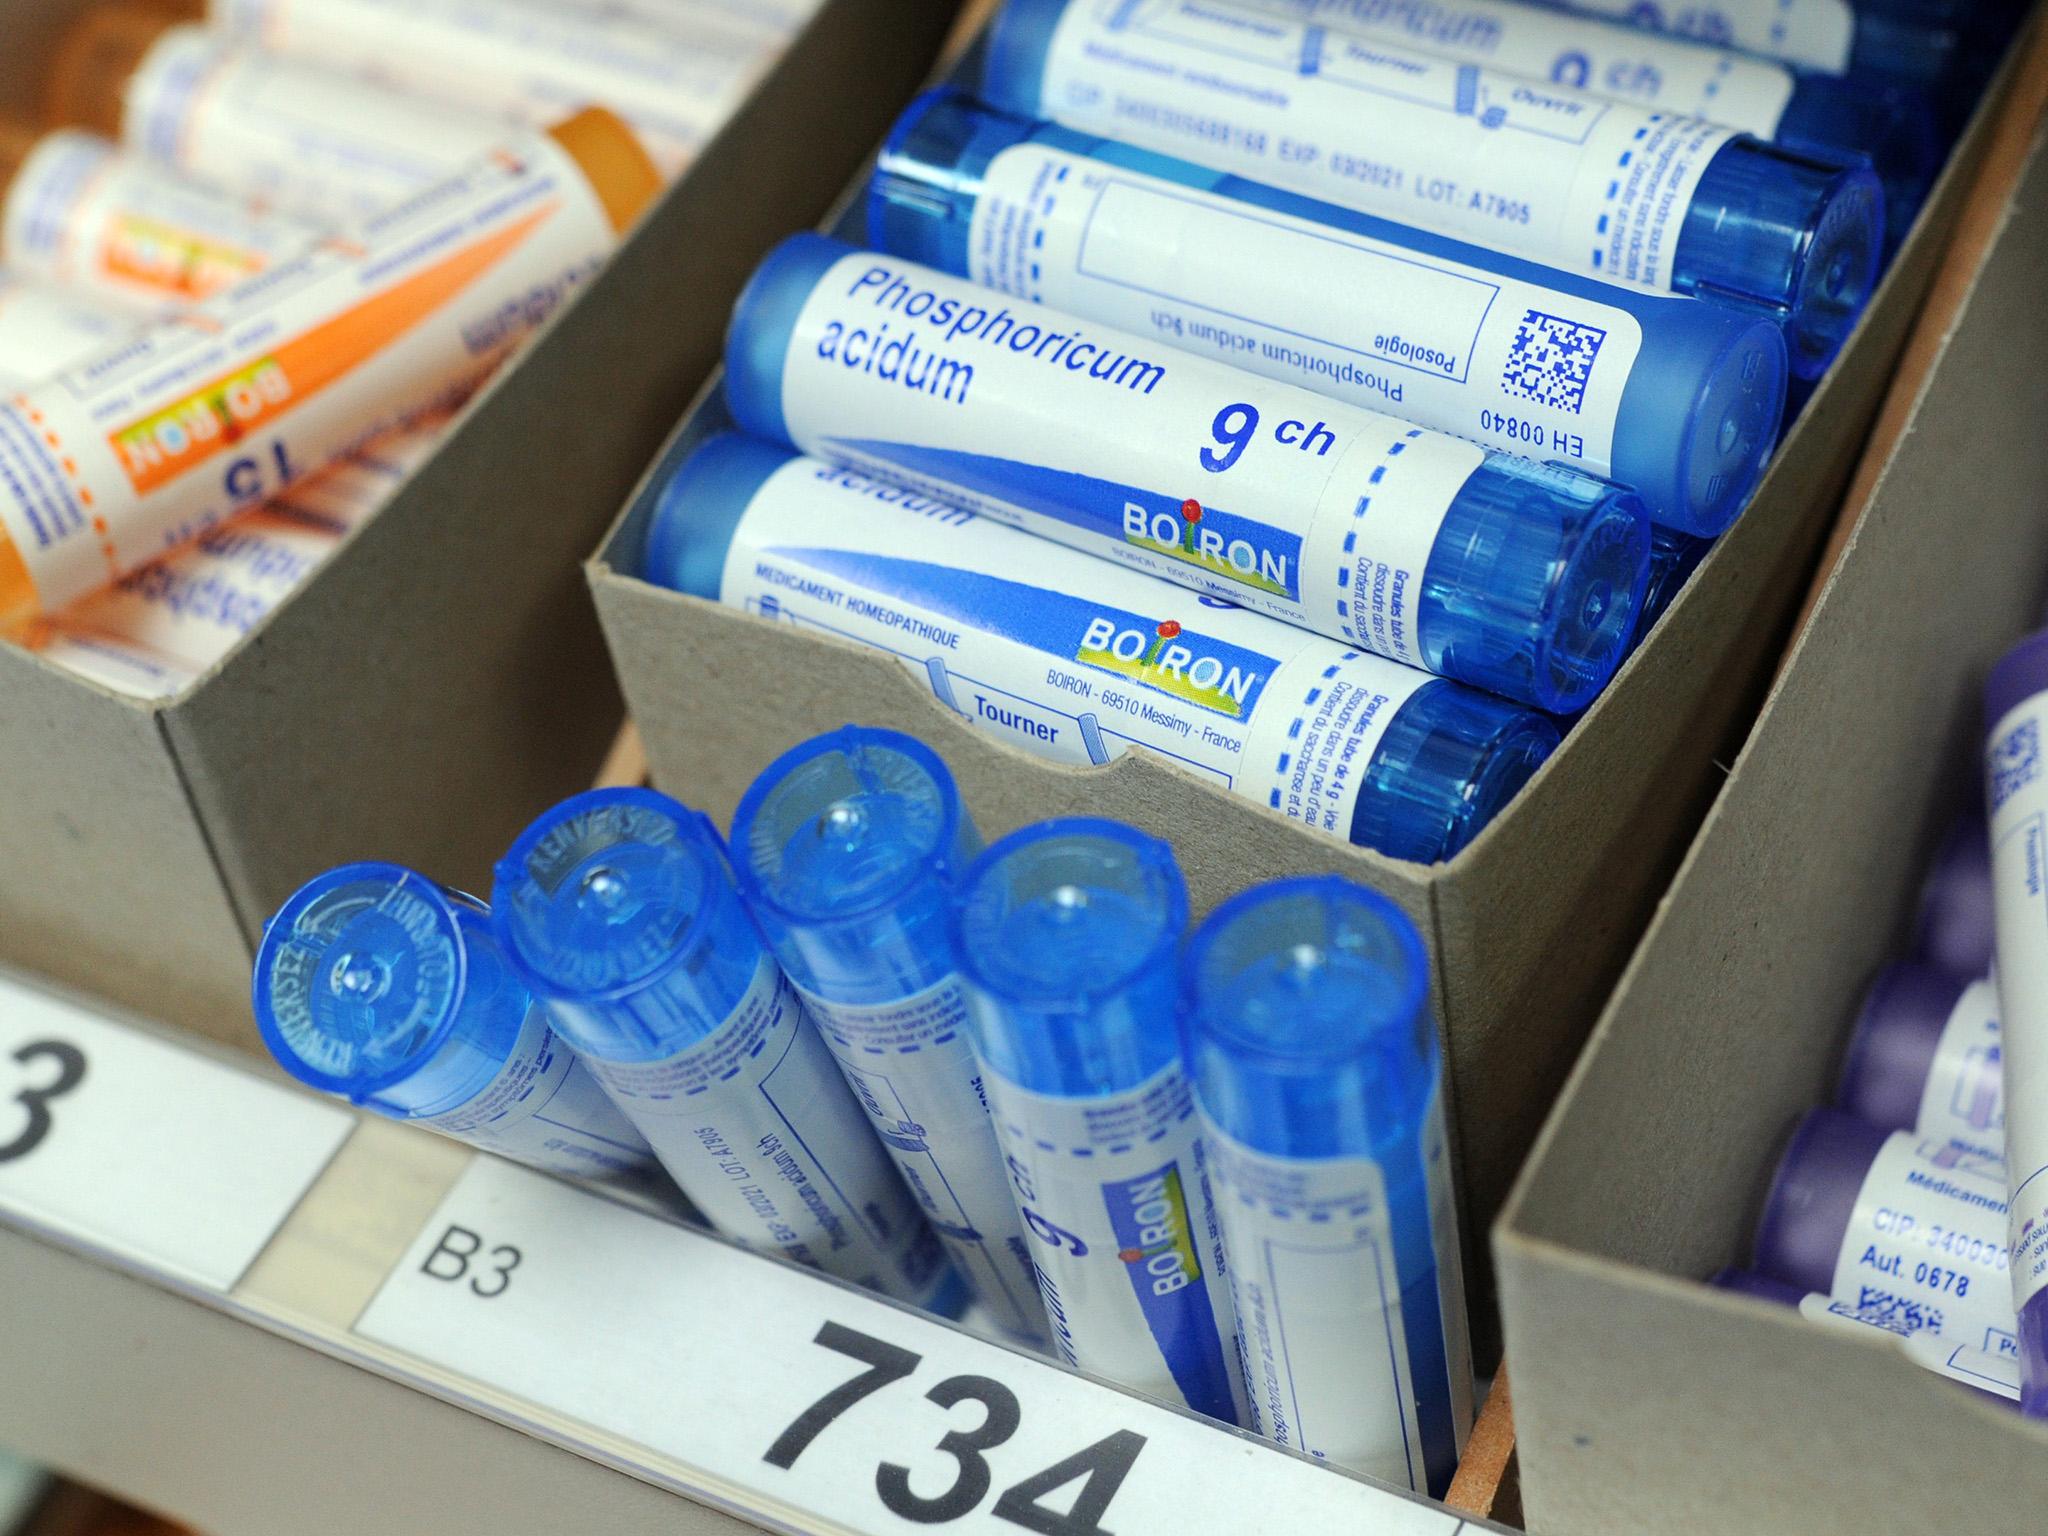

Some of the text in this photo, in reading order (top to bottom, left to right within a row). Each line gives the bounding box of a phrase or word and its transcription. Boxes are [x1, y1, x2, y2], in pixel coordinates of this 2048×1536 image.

[1467, 189, 1532, 226] A7905
[847, 266, 1167, 395] Phosphoricum
[1187, 321, 1256, 353] acidum
[1374, 333, 1456, 374] Posologie
[816, 319, 975, 405] acidum
[1262, 341, 1404, 402] Phosphoricum
[1199, 402, 1338, 474] 9 ch
[1480, 409, 1585, 459] EH 00840
[1123, 499, 1288, 588] BOIRON
[755, 563, 961, 650] MEDICAMENT HOMEOPATHIQUE
[1080, 617, 1257, 705] BOIRON
[974, 694, 1060, 744] Tourner
[1046, 669, 1092, 698] BOIRON
[1101, 690, 1139, 716] 69510
[1140, 704, 1192, 738] Messimy
[1201, 727, 1242, 753] France
[1312, 715, 1329, 731] du
[1323, 681, 1353, 717] Contient
[1333, 687, 1369, 731] dissoudre
[1353, 694, 1389, 736] Granules
[1290, 731, 1319, 793] saccharose
[1315, 758, 1330, 774] un
[1324, 730, 1341, 758] dans
[1342, 736, 1364, 763] tube
[1310, 772, 1325, 797] peu
[1334, 764, 1350, 780] de
[1323, 806, 1340, 832] Voie
[0, 1040, 88, 1164] 3
[694, 1126, 734, 1158] A7905
[718, 1153, 752, 1183] LOT:
[756, 1132, 778, 1158] 9ch
[772, 1148, 808, 1188] acidum
[1021, 1206, 1090, 1258] 9
[1118, 1174, 1191, 1298] BOIRON
[419, 1224, 524, 1298] B3
[1860, 1245, 1971, 1299] Aut. 0678
[763, 1319, 1149, 1536] 734
